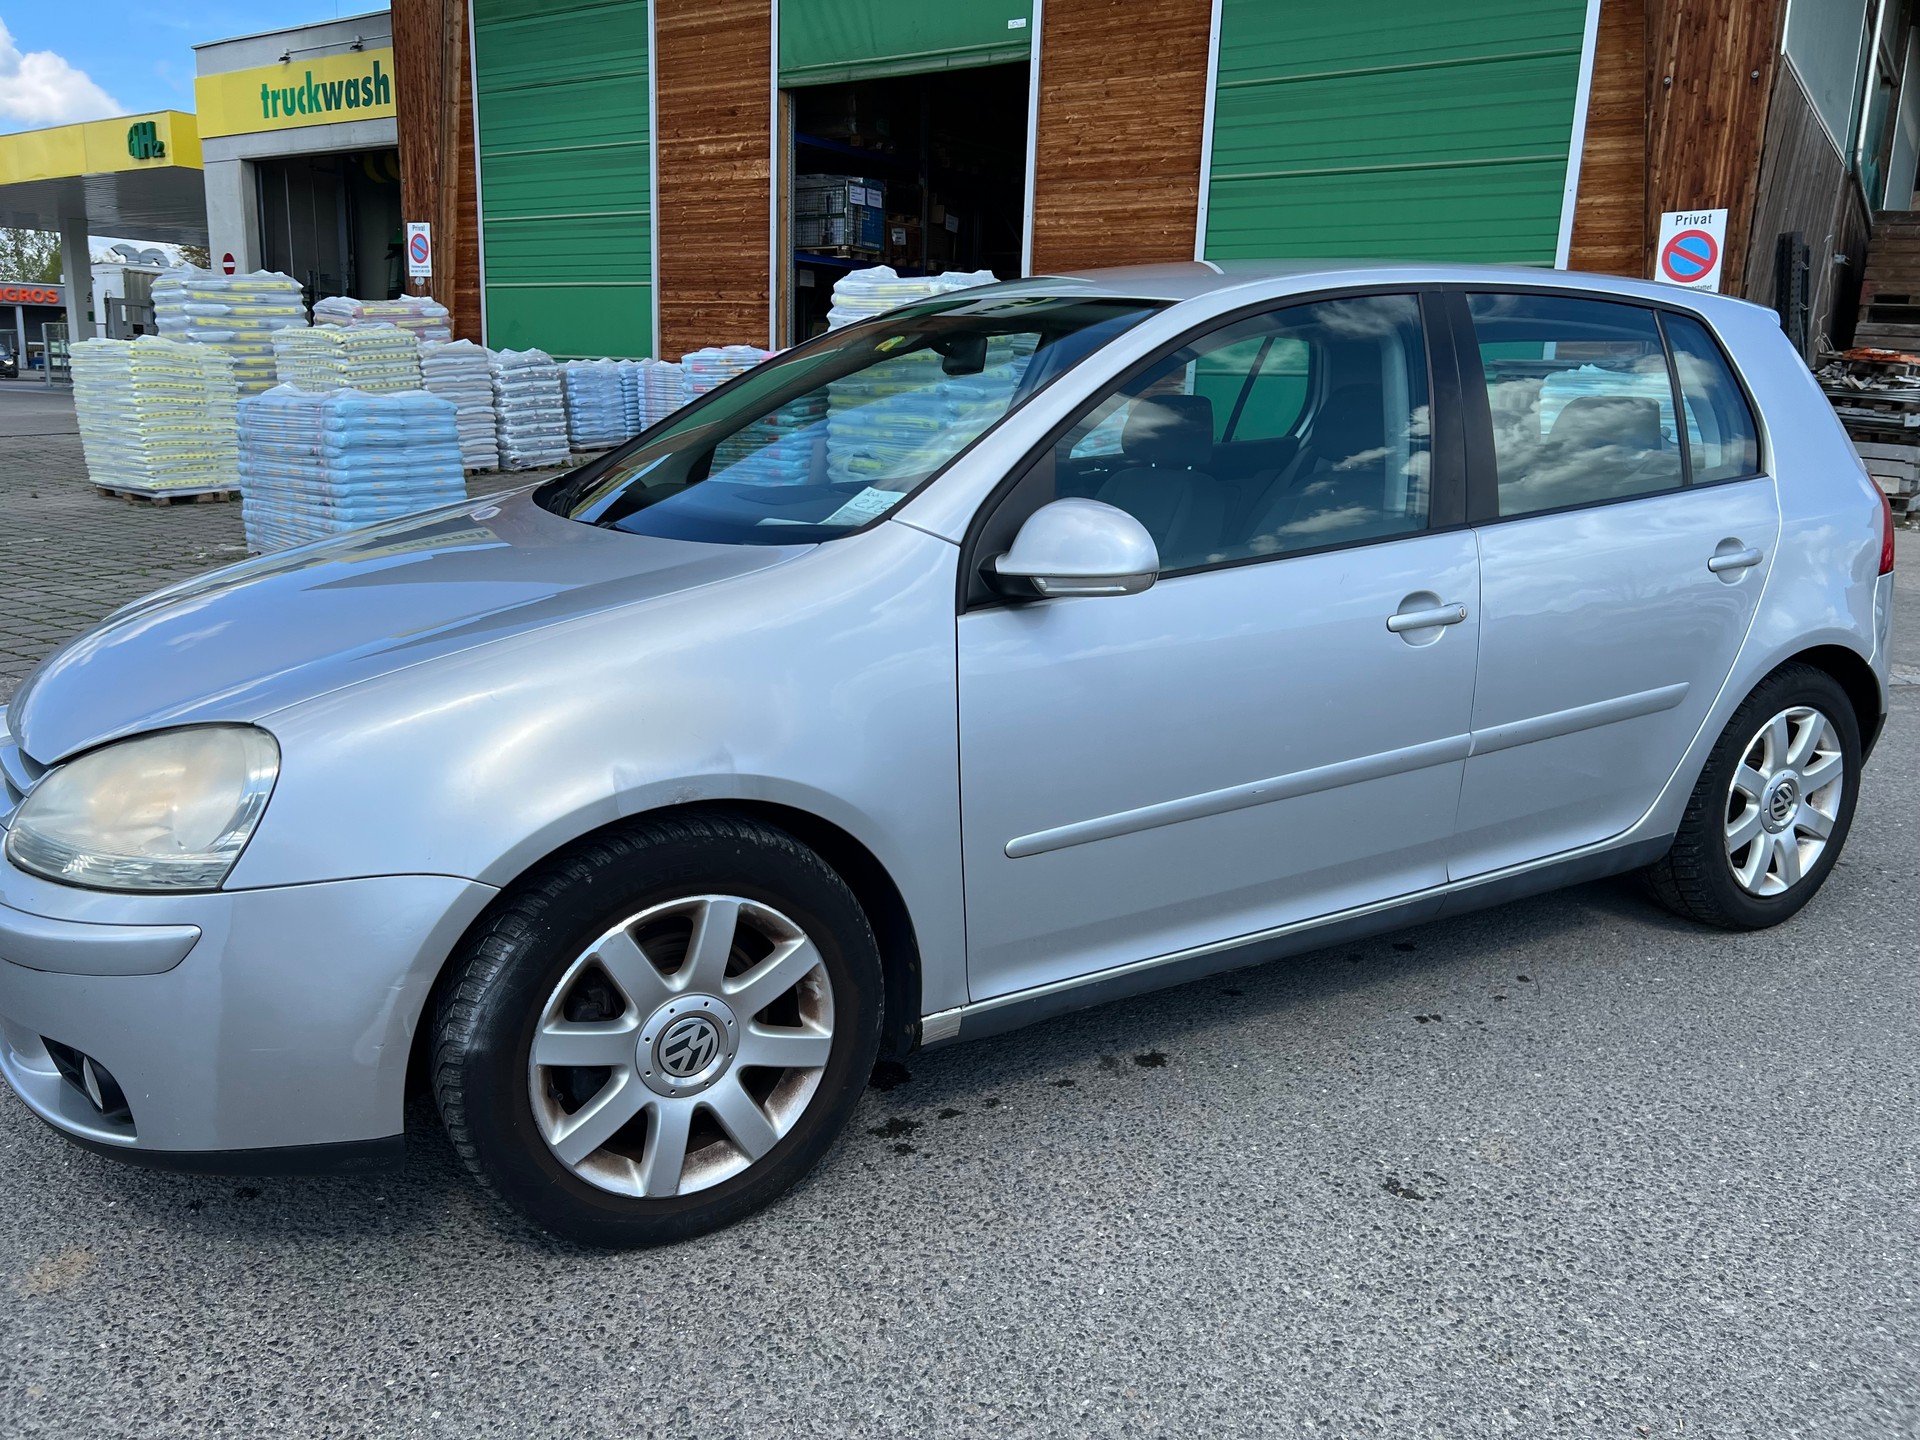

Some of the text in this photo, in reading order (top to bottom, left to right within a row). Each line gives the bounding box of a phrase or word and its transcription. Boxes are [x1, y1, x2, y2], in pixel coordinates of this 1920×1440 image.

[261, 60, 391, 119] truckwash
[1675, 213, 1713, 226] Privat
[0, 287, 59, 304] IGROS
